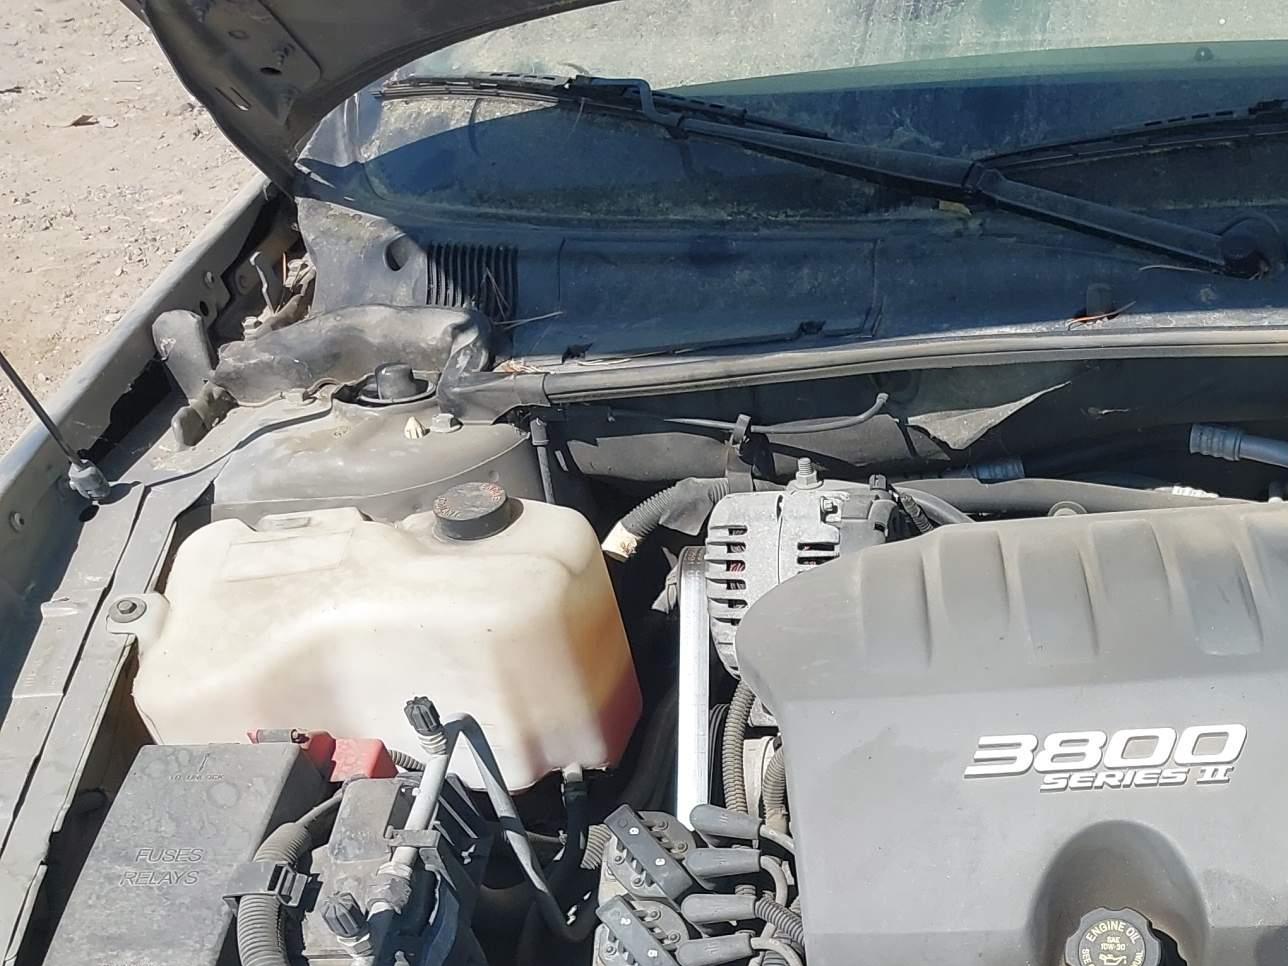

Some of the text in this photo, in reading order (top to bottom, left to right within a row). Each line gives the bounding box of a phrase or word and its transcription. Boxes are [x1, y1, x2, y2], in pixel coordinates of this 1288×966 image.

[964, 723, 1248, 778] 3800
[1040, 765, 1235, 793] SERIES II
[135, 848, 204, 864] FUSES
[119, 870, 201, 886] RELAYS
[1086, 920, 1141, 945] ENGINE OIL
[1106, 936, 1121, 944] SAE
[1100, 943, 1126, 951] 10W-30
[1081, 948, 1092, 965] SEE
